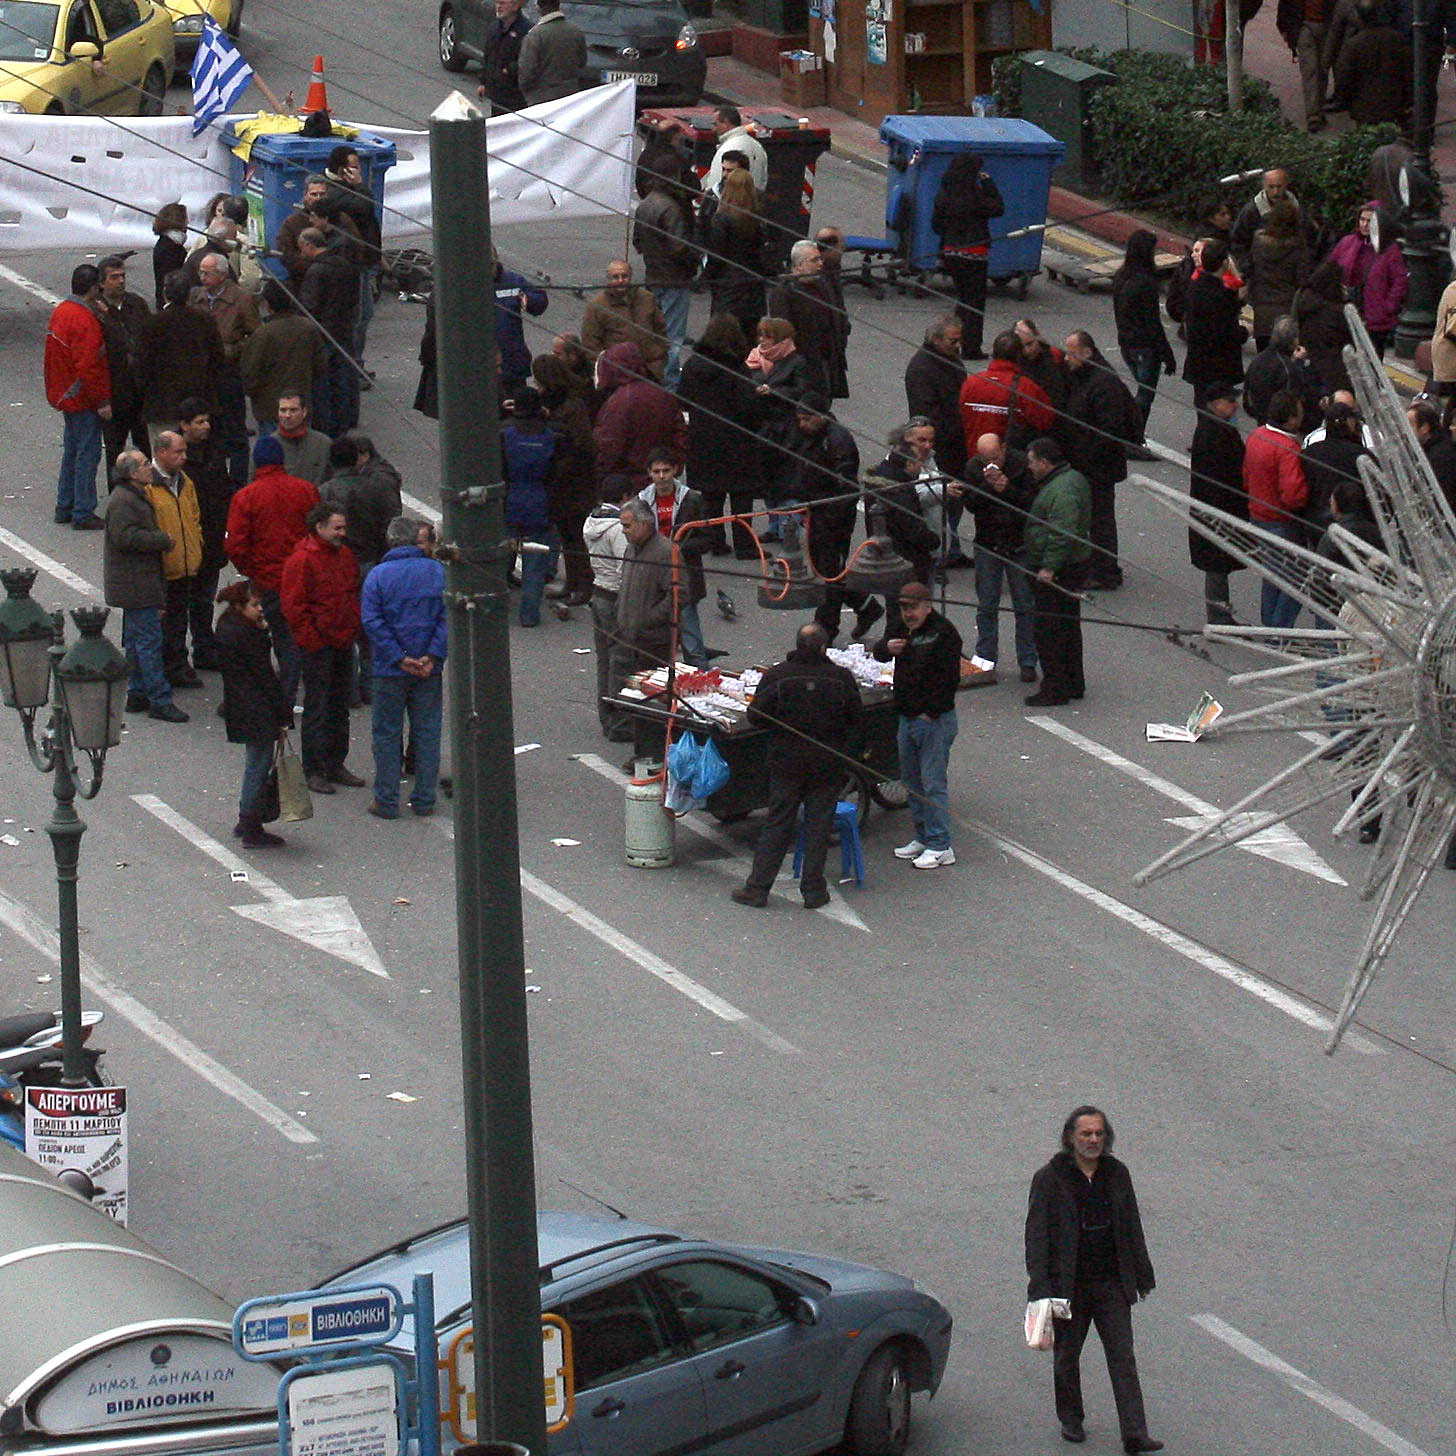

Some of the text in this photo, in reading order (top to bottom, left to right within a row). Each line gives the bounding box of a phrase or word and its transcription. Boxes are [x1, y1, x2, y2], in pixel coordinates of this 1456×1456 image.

[38, 1093, 117, 1111] ΑΠΕΡΓΟΥΜΕ
[33, 1117, 122, 1130] ΠΕΜΠΤΗ 11 ΜΑΡΤΙΟΥ
[317, 1307, 385, 1331] ΒΙΒΛΙΟΘΗΚΗ
[88, 1367, 235, 1396] ΔΗΜΟΣ ΑΘΗΝΑΙΩΝ
[106, 1391, 215, 1414] ΒΙΒΛΙΟΘΗΚΗ
